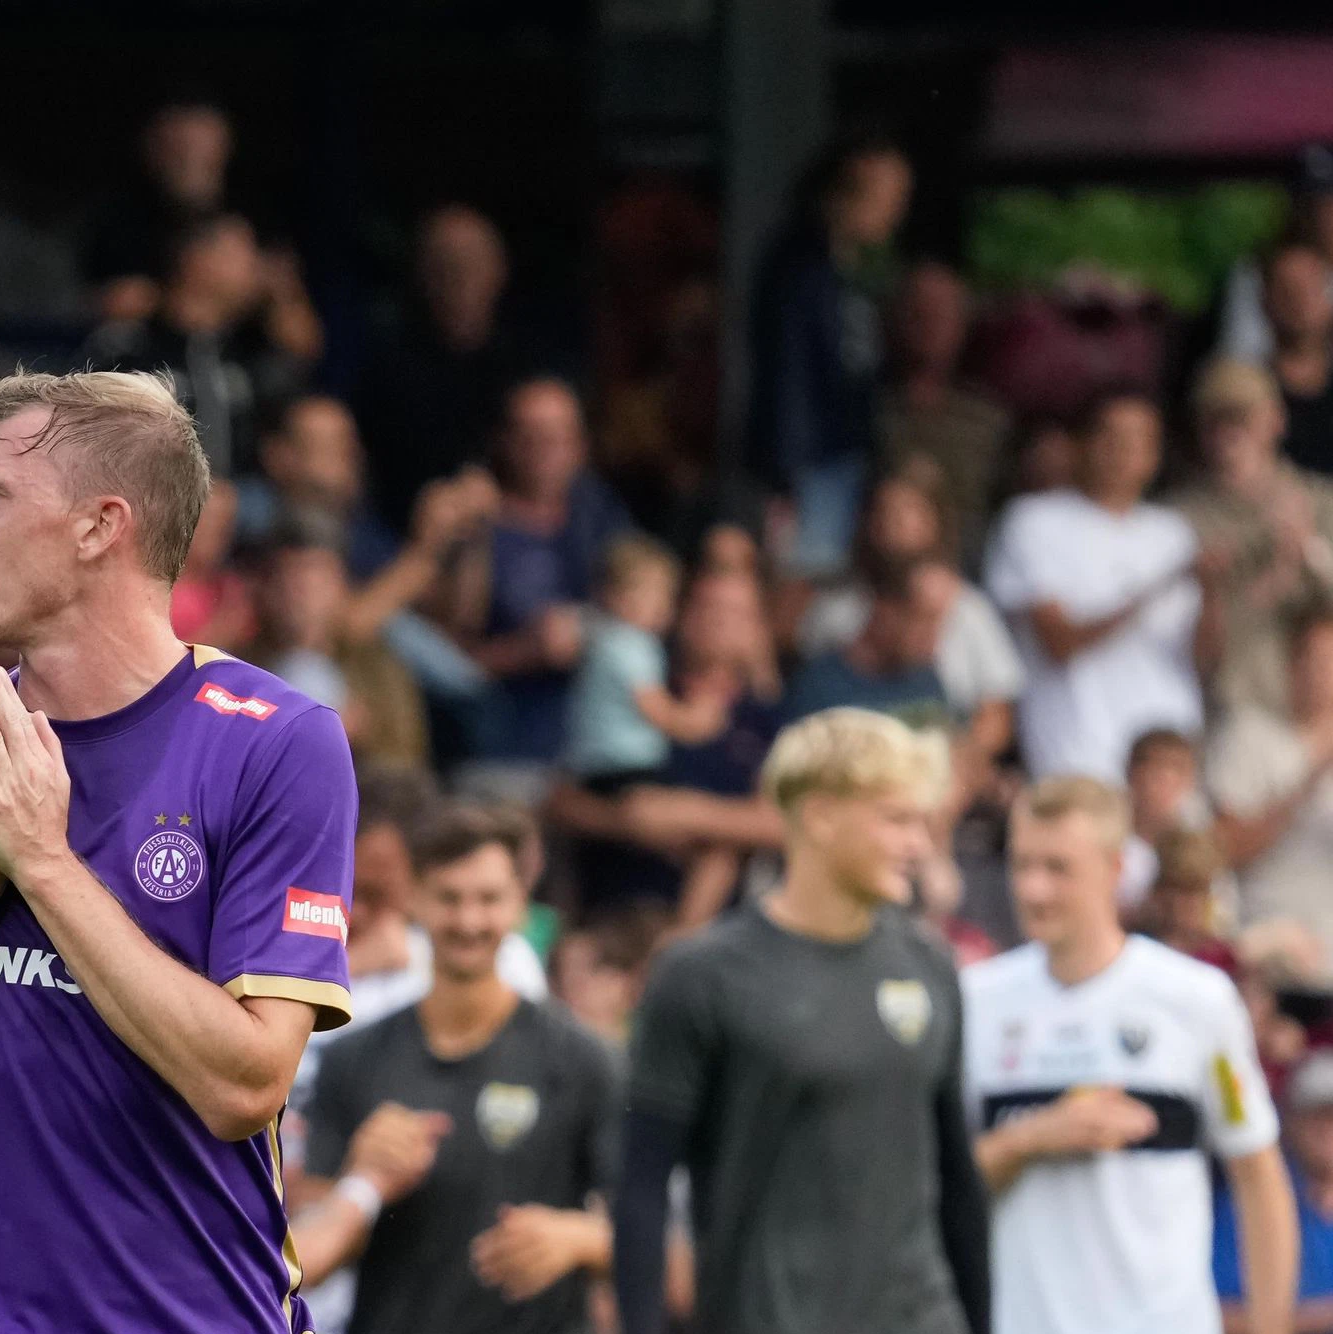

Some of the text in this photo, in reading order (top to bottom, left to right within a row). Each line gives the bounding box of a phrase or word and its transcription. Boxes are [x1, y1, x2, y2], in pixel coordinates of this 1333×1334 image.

[143, 835, 197, 857] FUSSBALLKLUB
[142, 877, 194, 896] AUSTRIA WIEN
